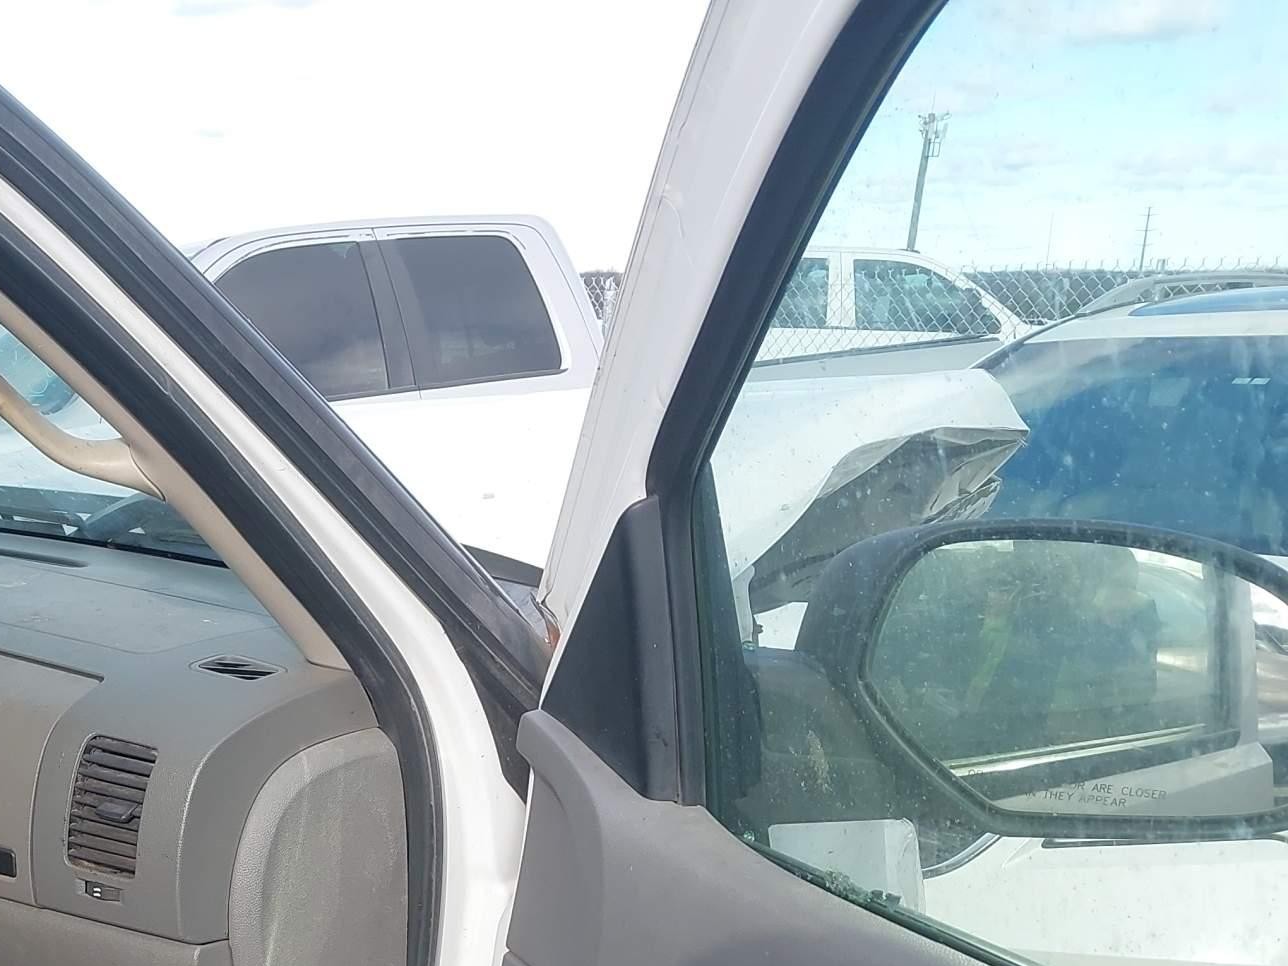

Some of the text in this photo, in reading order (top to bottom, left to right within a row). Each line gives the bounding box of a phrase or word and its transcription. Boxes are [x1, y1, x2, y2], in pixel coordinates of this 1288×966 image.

[1043, 790, 1074, 801] THEY
[1078, 794, 1127, 808] APPEAR
[1091, 783, 1113, 795] ARE
[1120, 786, 1167, 800] CLOSER
